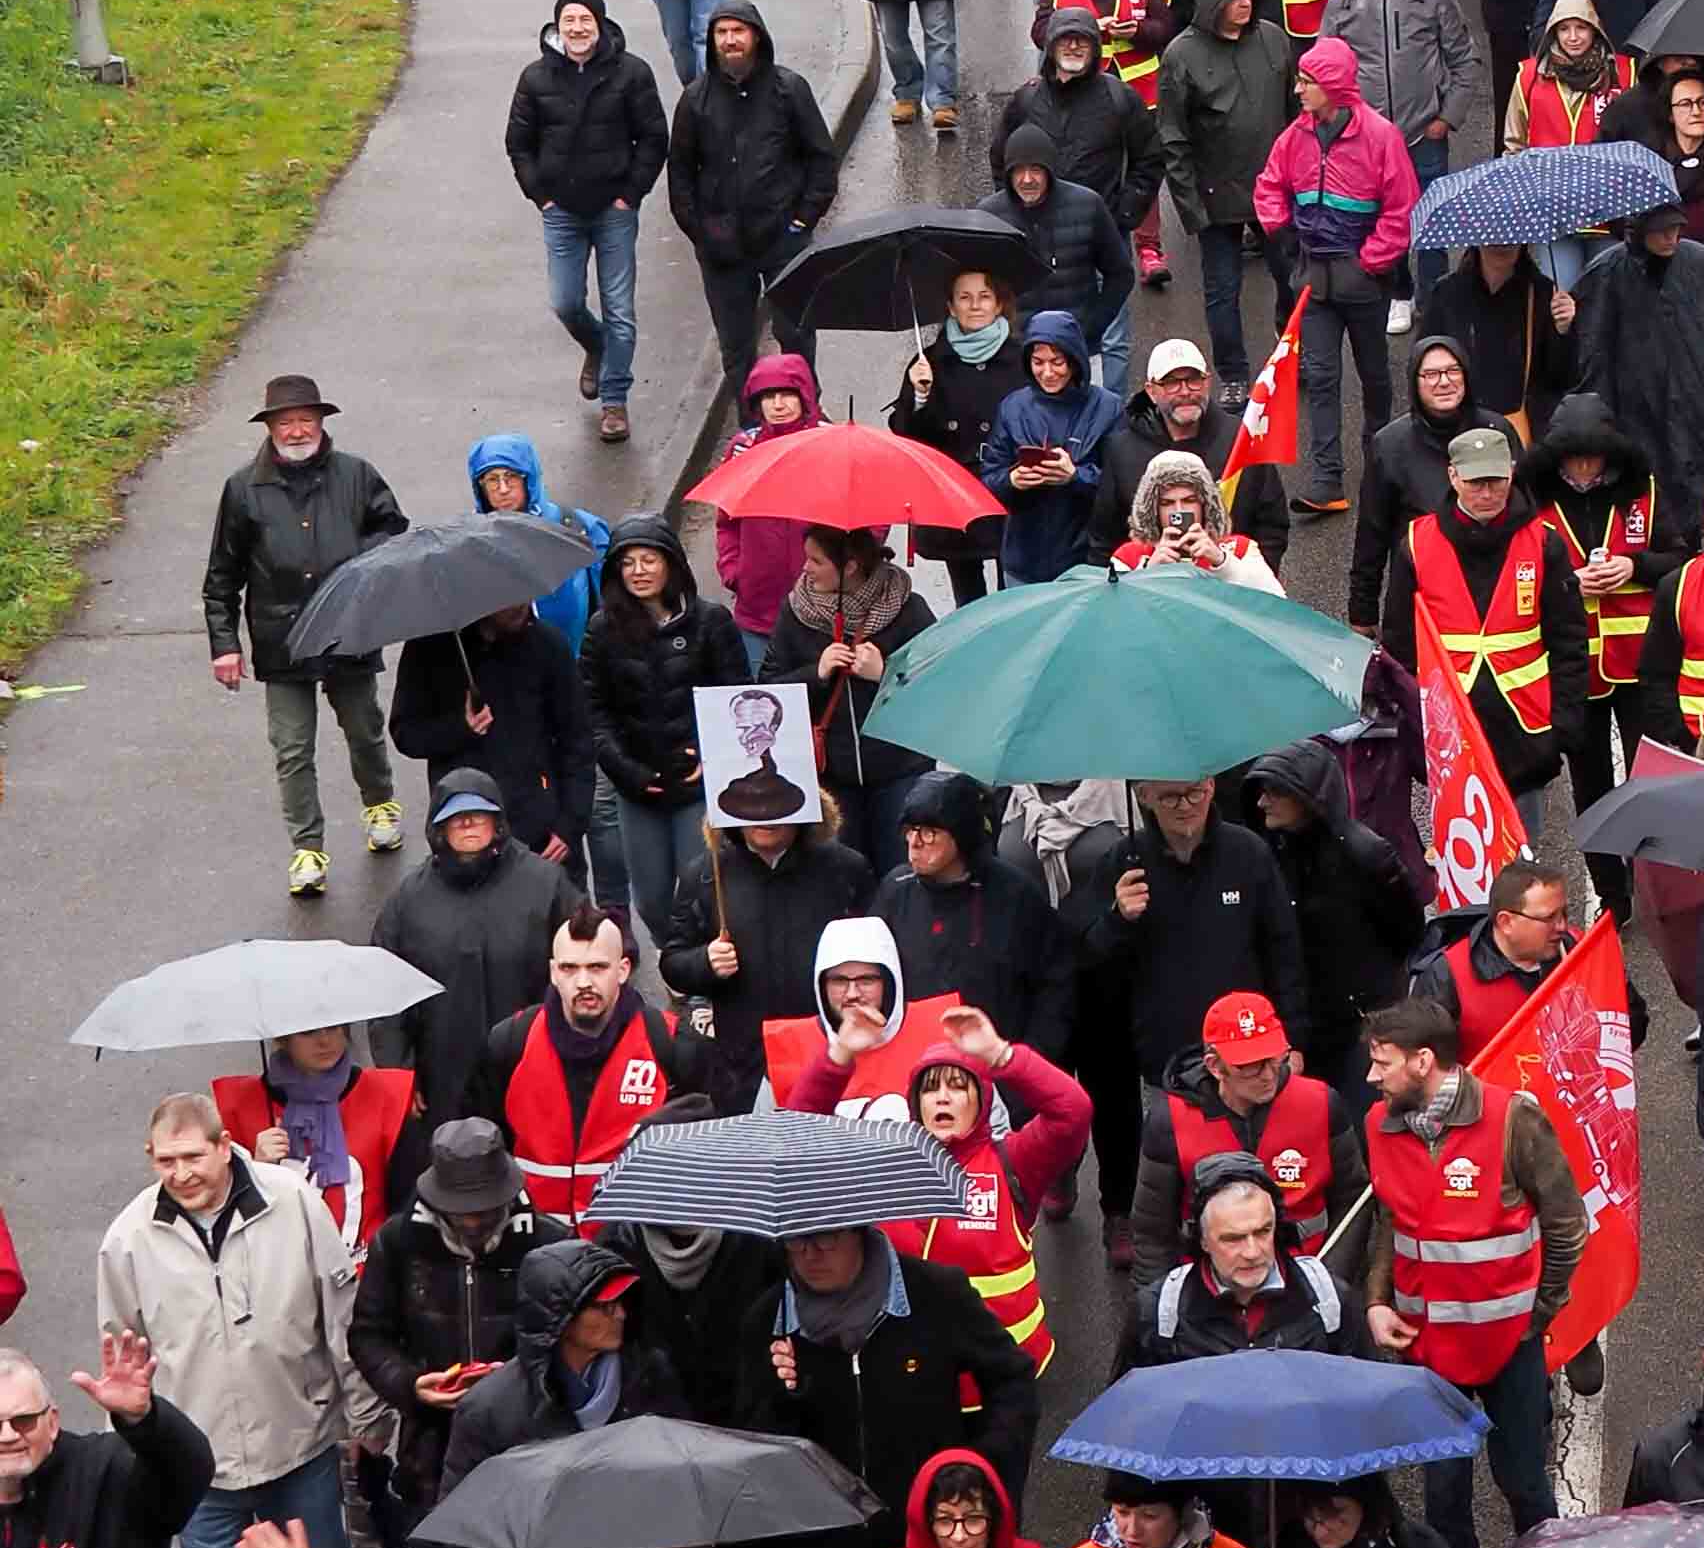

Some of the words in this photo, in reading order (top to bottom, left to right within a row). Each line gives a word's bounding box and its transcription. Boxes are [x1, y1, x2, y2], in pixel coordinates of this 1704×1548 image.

[619, 1093, 636, 1104] UD
[638, 1094, 653, 1105] 85
[1278, 1165, 1300, 1182] cgt
[1449, 1175, 1473, 1191] cgt
